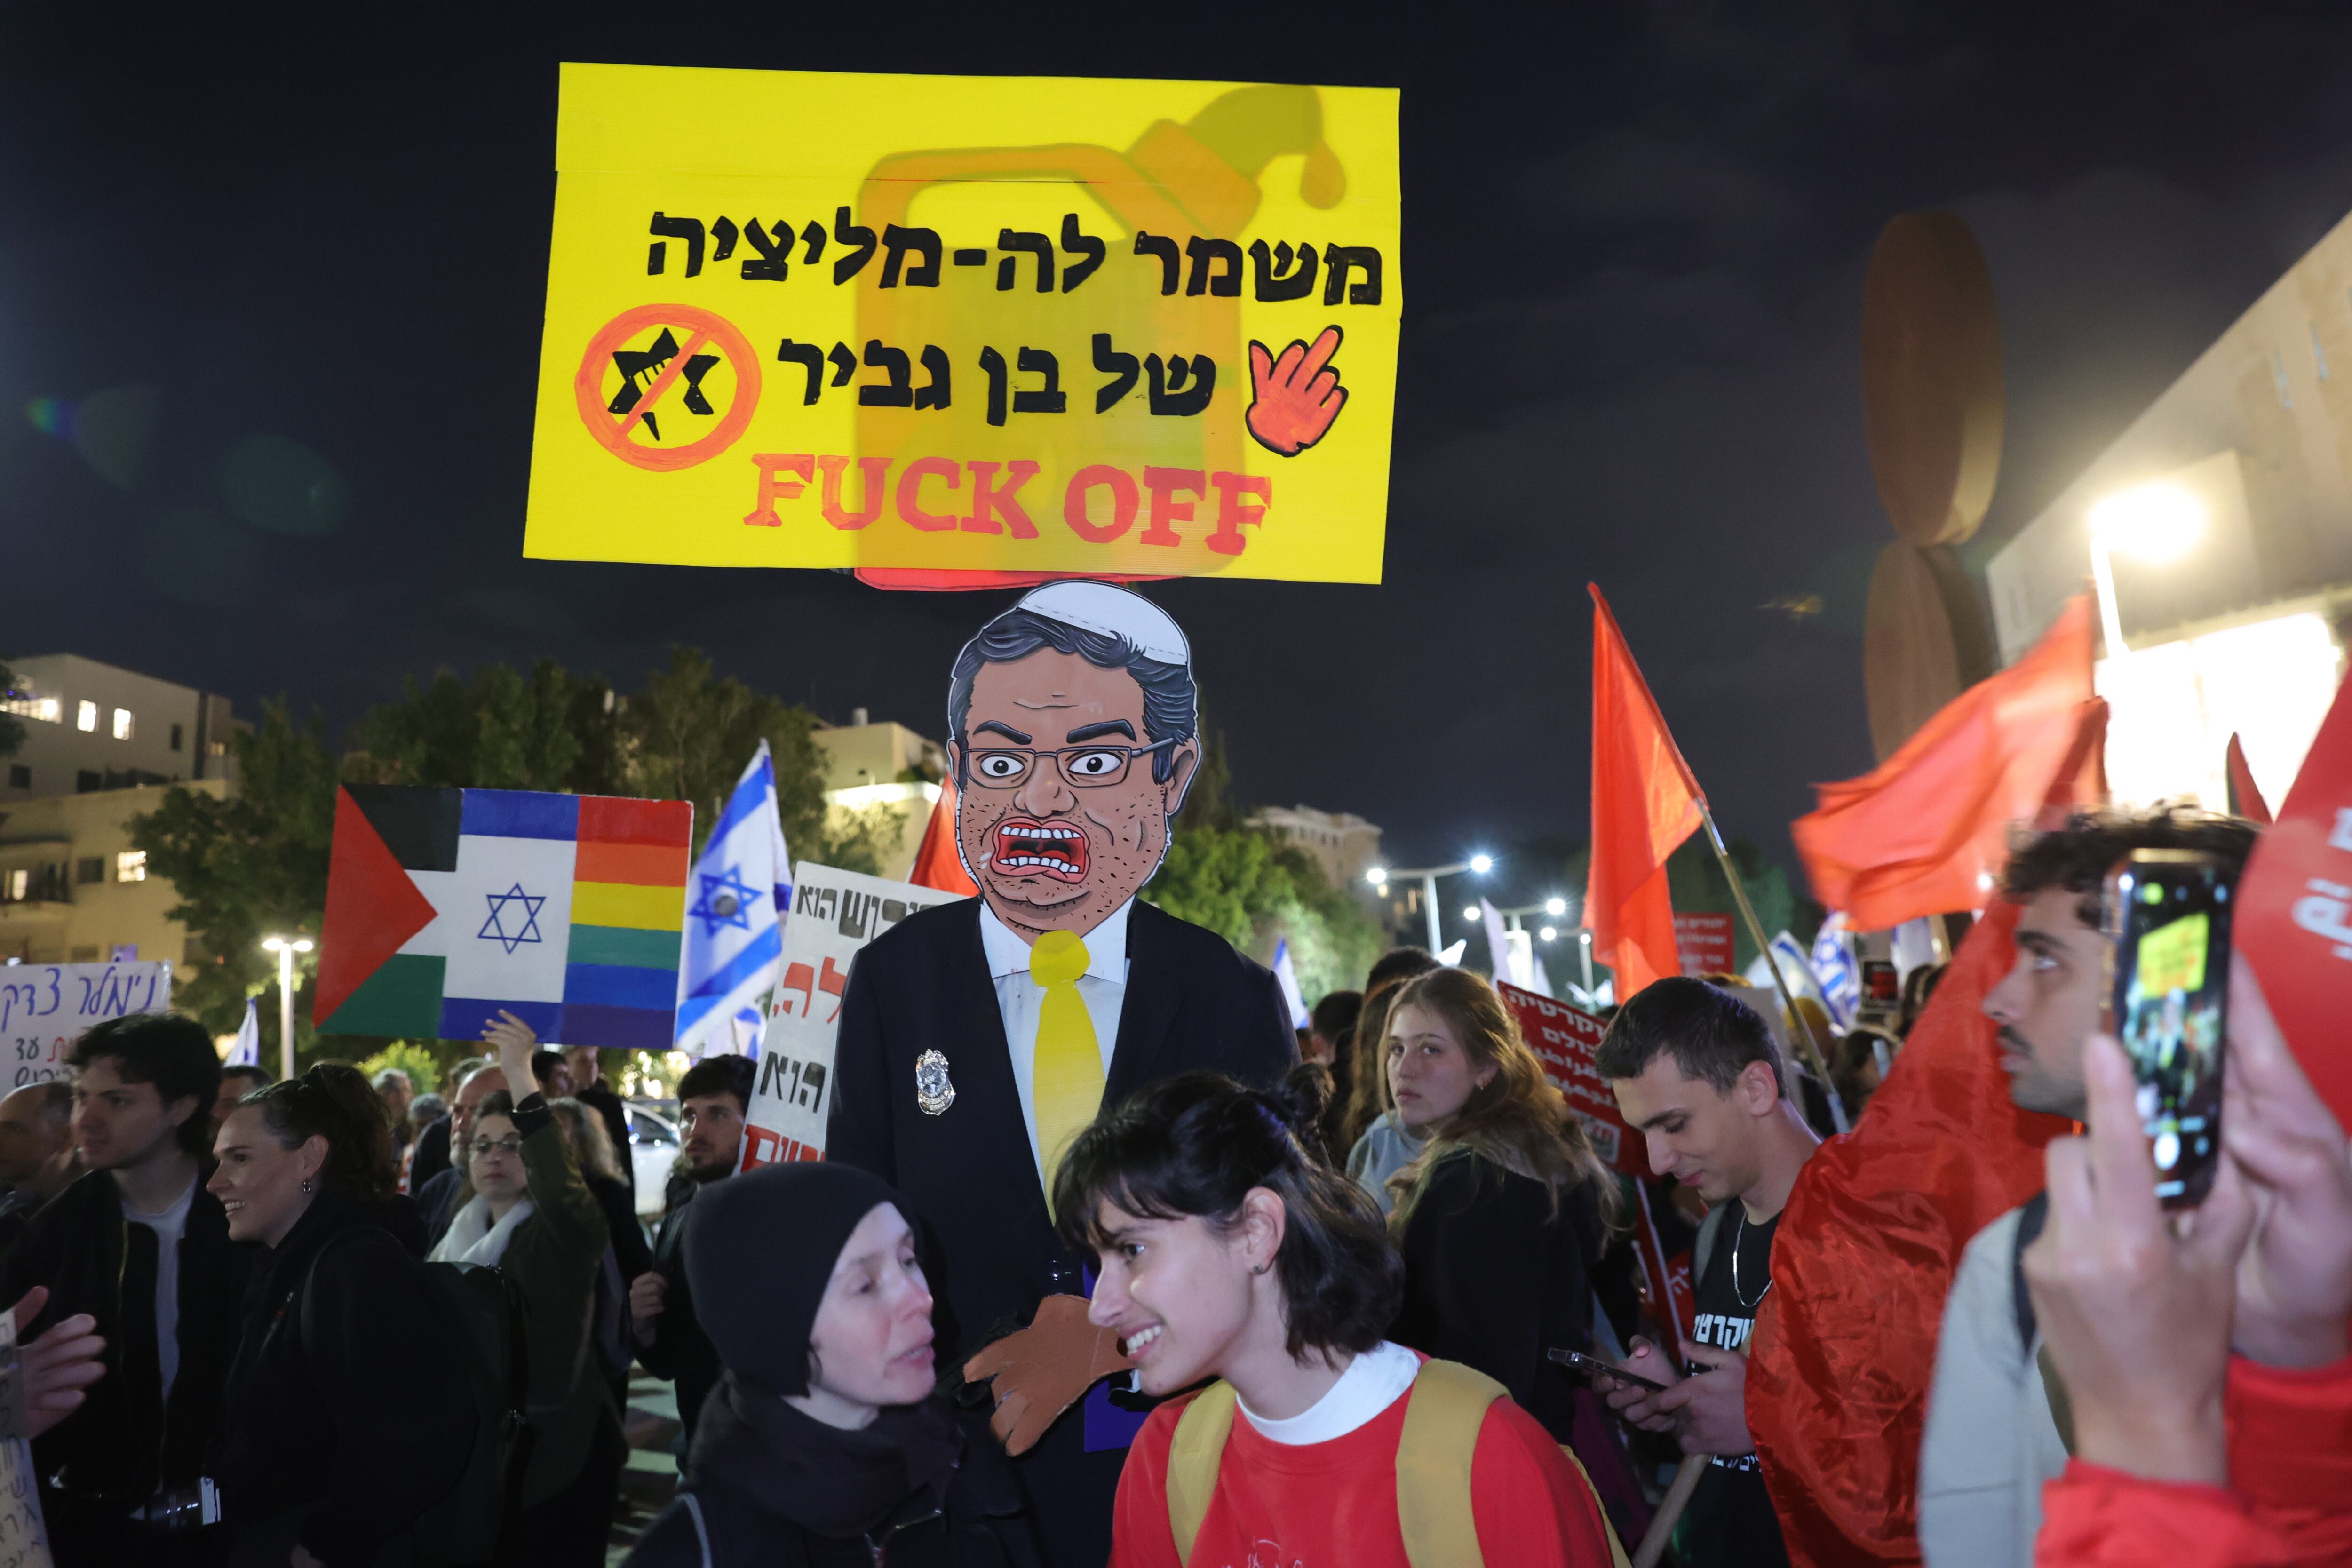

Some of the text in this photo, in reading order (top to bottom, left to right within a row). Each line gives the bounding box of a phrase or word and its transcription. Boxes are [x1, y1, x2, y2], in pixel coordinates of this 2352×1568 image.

[647, 206, 1382, 306] משמר לה-מליציה
[777, 333, 1216, 427] של בן גביר
[743, 453, 1273, 557] FUCK OFF
[796, 885, 837, 921] הוא
[1, 968, 61, 1032] צדק
[759, 1051, 826, 1114] הוא
